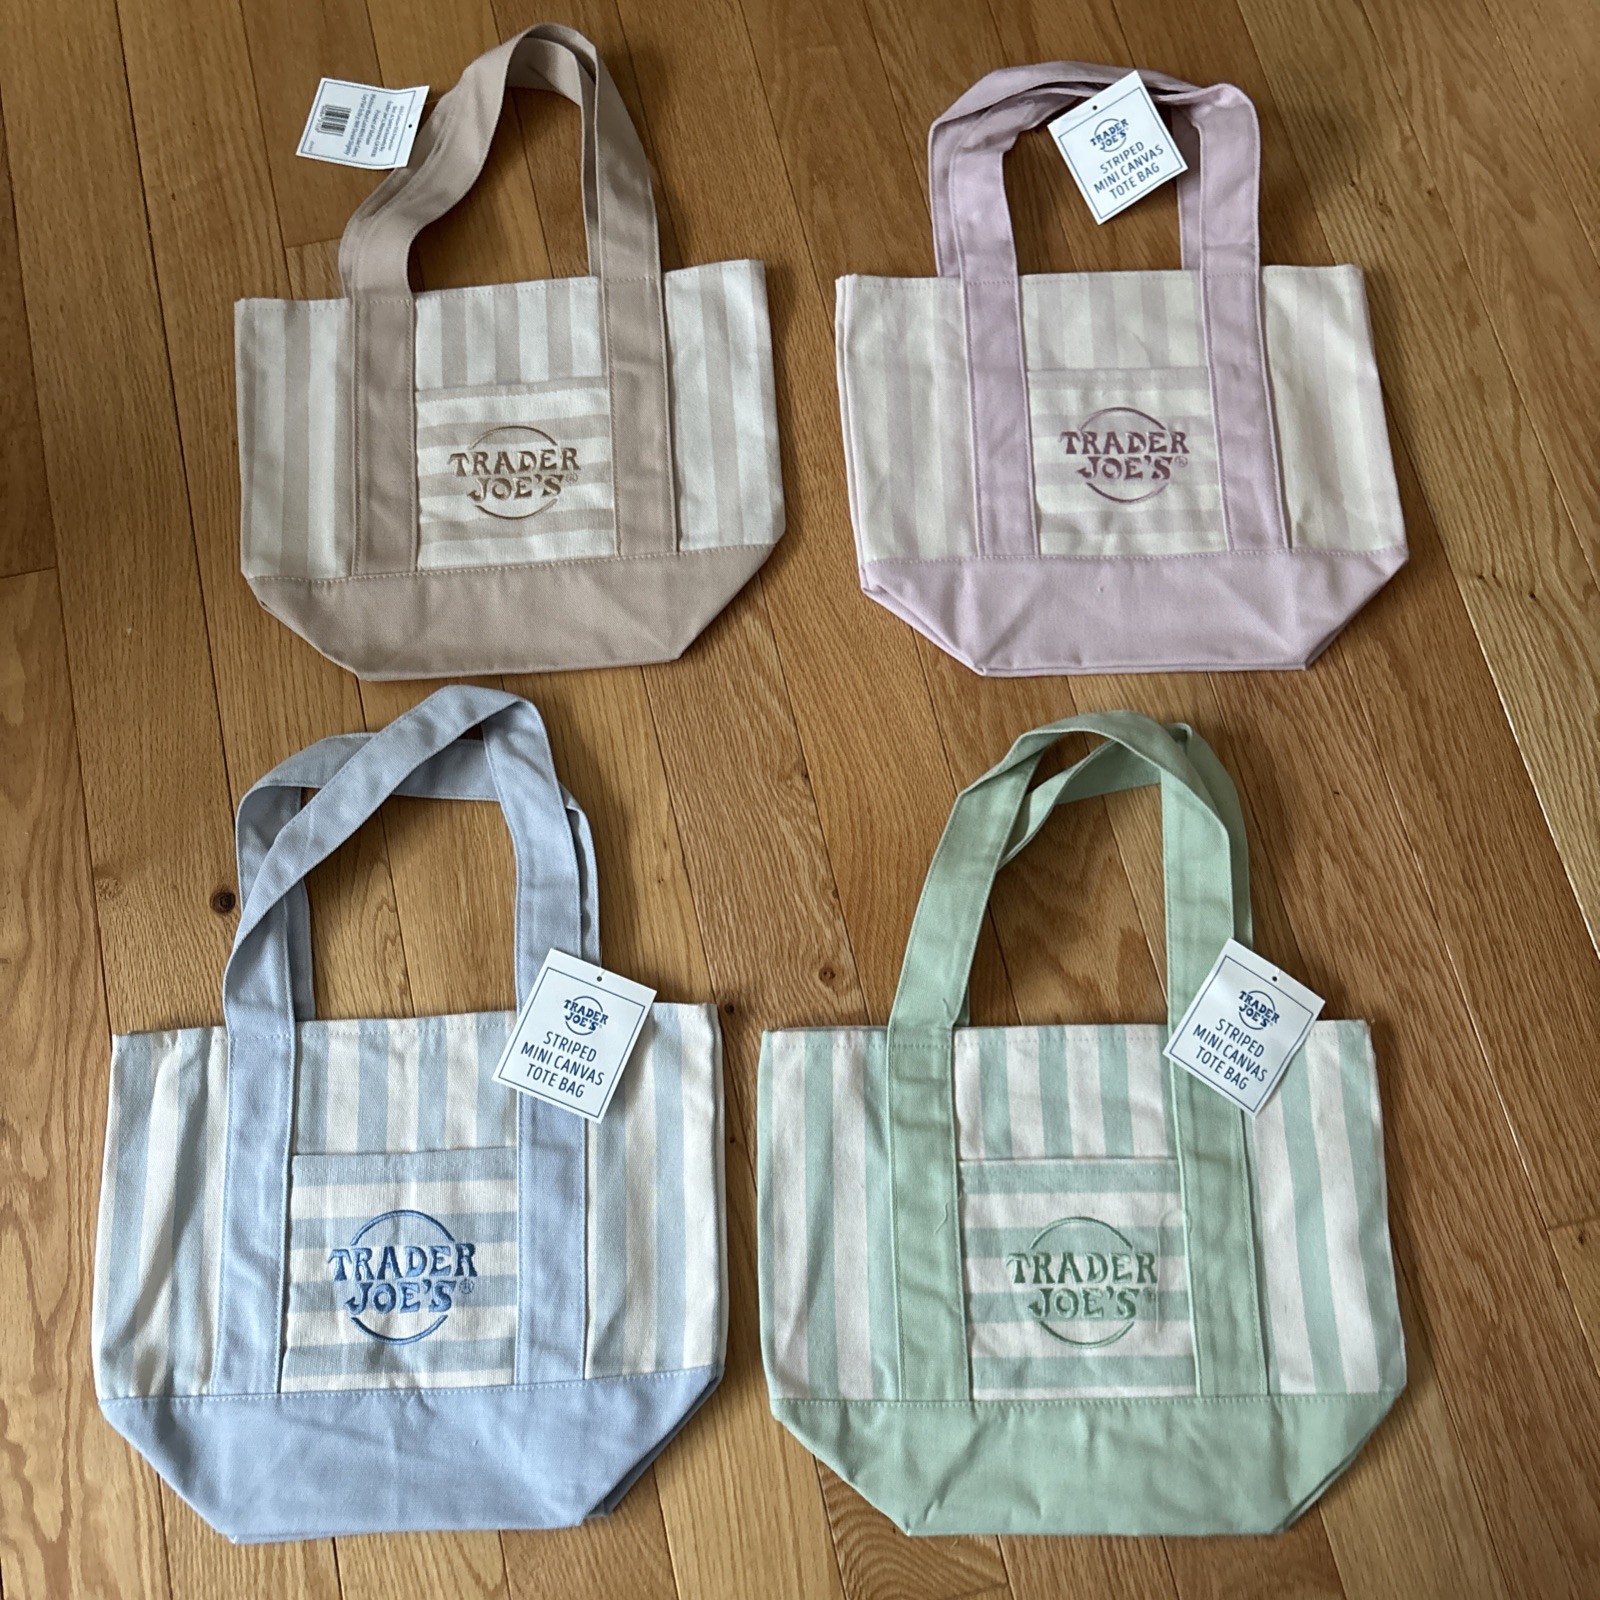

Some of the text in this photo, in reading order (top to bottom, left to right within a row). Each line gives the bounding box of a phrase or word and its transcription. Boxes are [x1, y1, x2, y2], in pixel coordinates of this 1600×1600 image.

[1090, 119, 1128, 146] TRADER
[1094, 145, 1164, 194] MINI CANVAS
[1100, 142, 1144, 174] STRIPED
[1109, 162, 1159, 199] TOTE BAG
[1059, 432, 1190, 454] TRADER
[447, 448, 581, 477] TRADER
[564, 999, 608, 1025] TRADER
[1239, 991, 1280, 1023] TRADER
[543, 1031, 597, 1062] STRIPED
[1193, 1025, 1267, 1082] MINI CANVAS
[1216, 1019, 1264, 1058] STRIPED
[521, 1042, 604, 1086] MINI CANVAS
[1196, 1046, 1249, 1090] TOTE BAG
[527, 1064, 585, 1098] TOTE BAG
[328, 1243, 477, 1281] TRADER
[1006, 1252, 1157, 1284] TRADER
